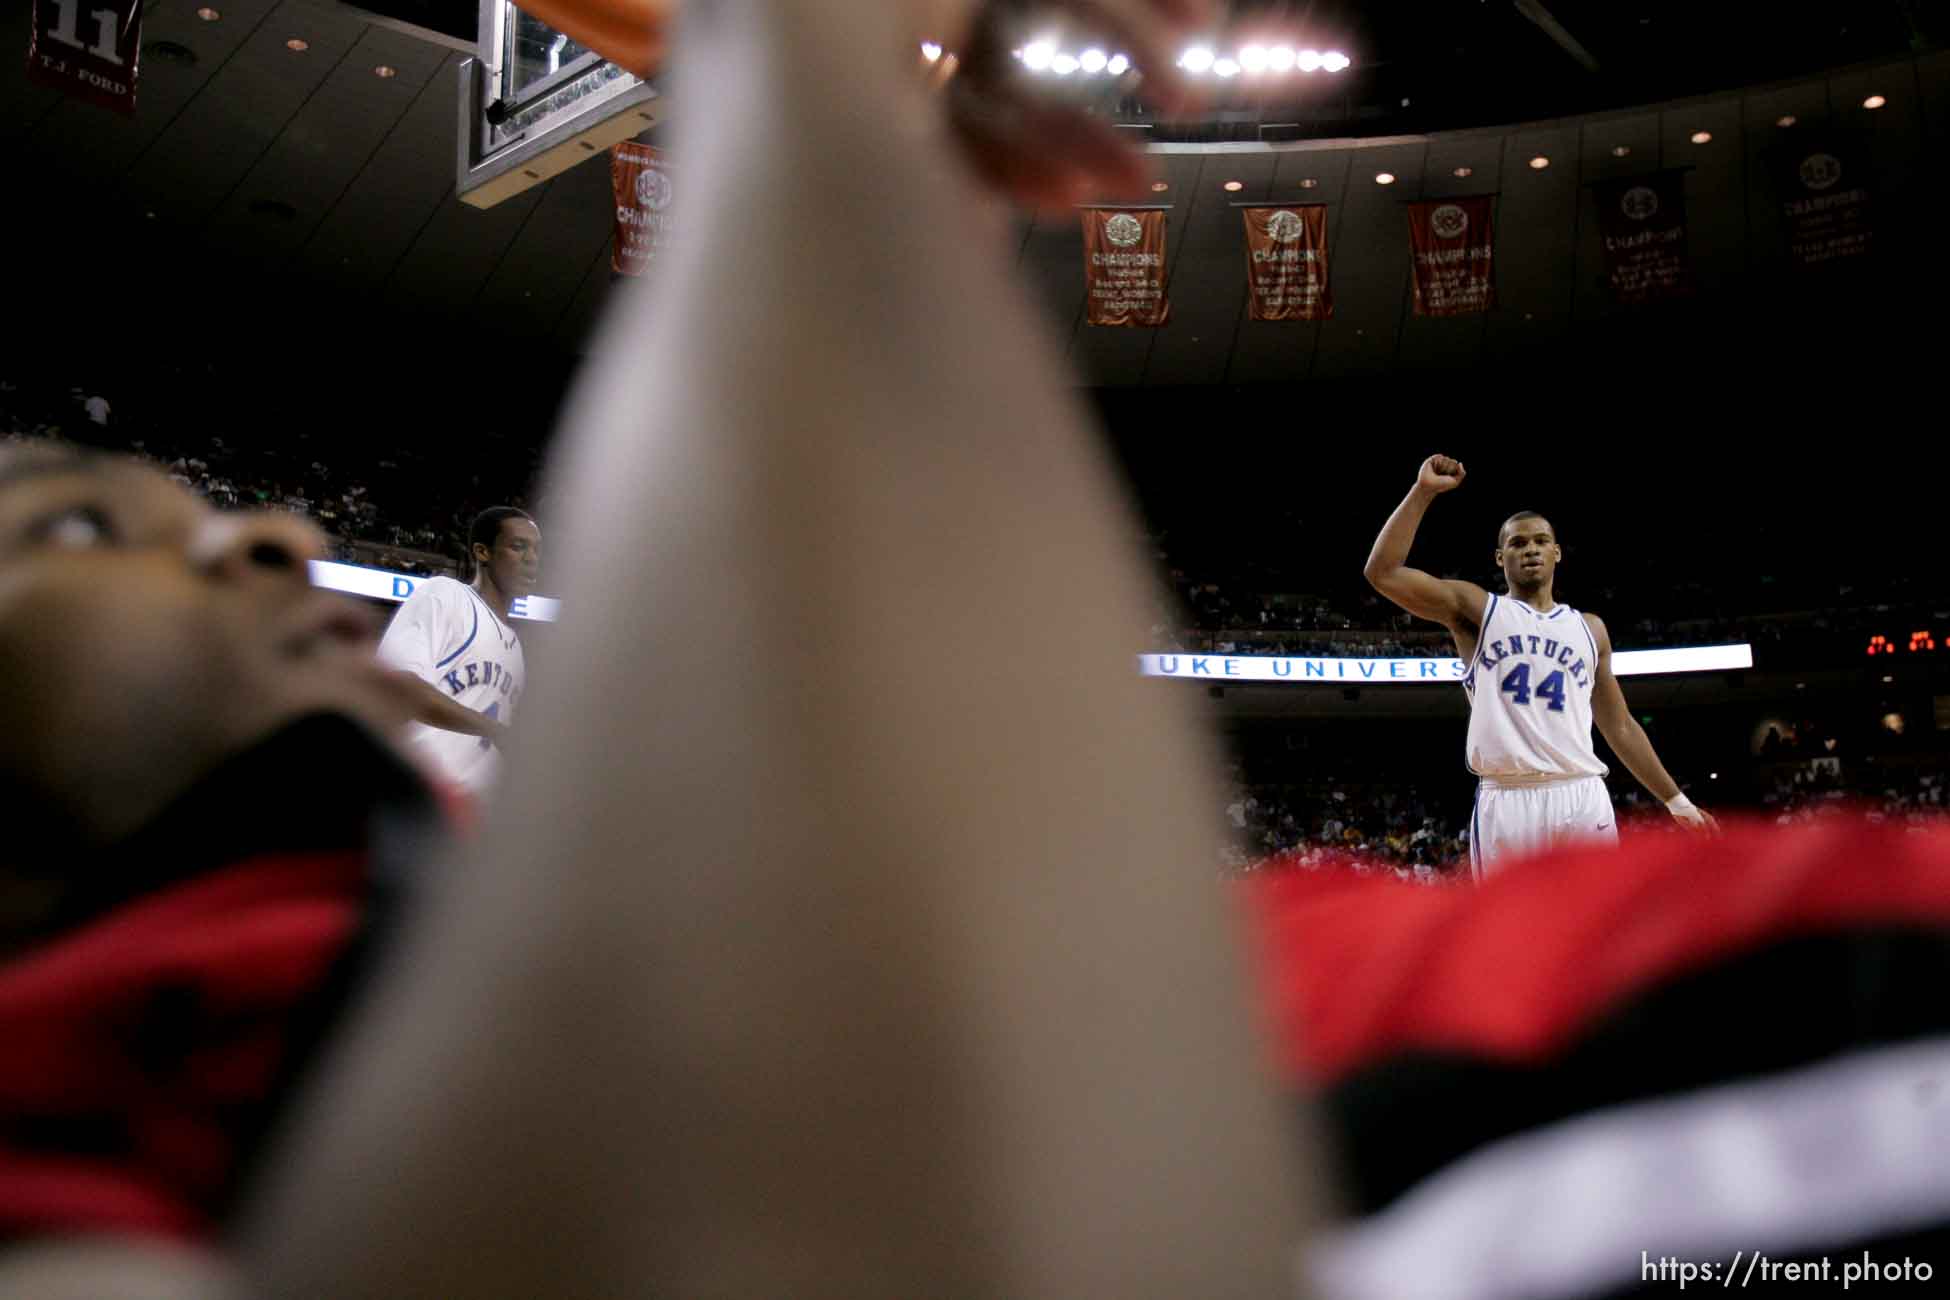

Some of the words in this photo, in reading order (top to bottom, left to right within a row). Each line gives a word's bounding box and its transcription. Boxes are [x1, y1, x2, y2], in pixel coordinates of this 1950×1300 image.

[47, 0, 125, 65] 11
[77, 68, 128, 96] FORD
[1092, 252, 1160, 267] CHAMPIONS
[443, 661, 514, 695] KENTU
[1159, 655, 1241, 676] UKE
[1272, 660, 1467, 678] UNIVERS
[1479, 634, 1589, 689] KENTUCKY
[1501, 661, 1566, 712] 44
